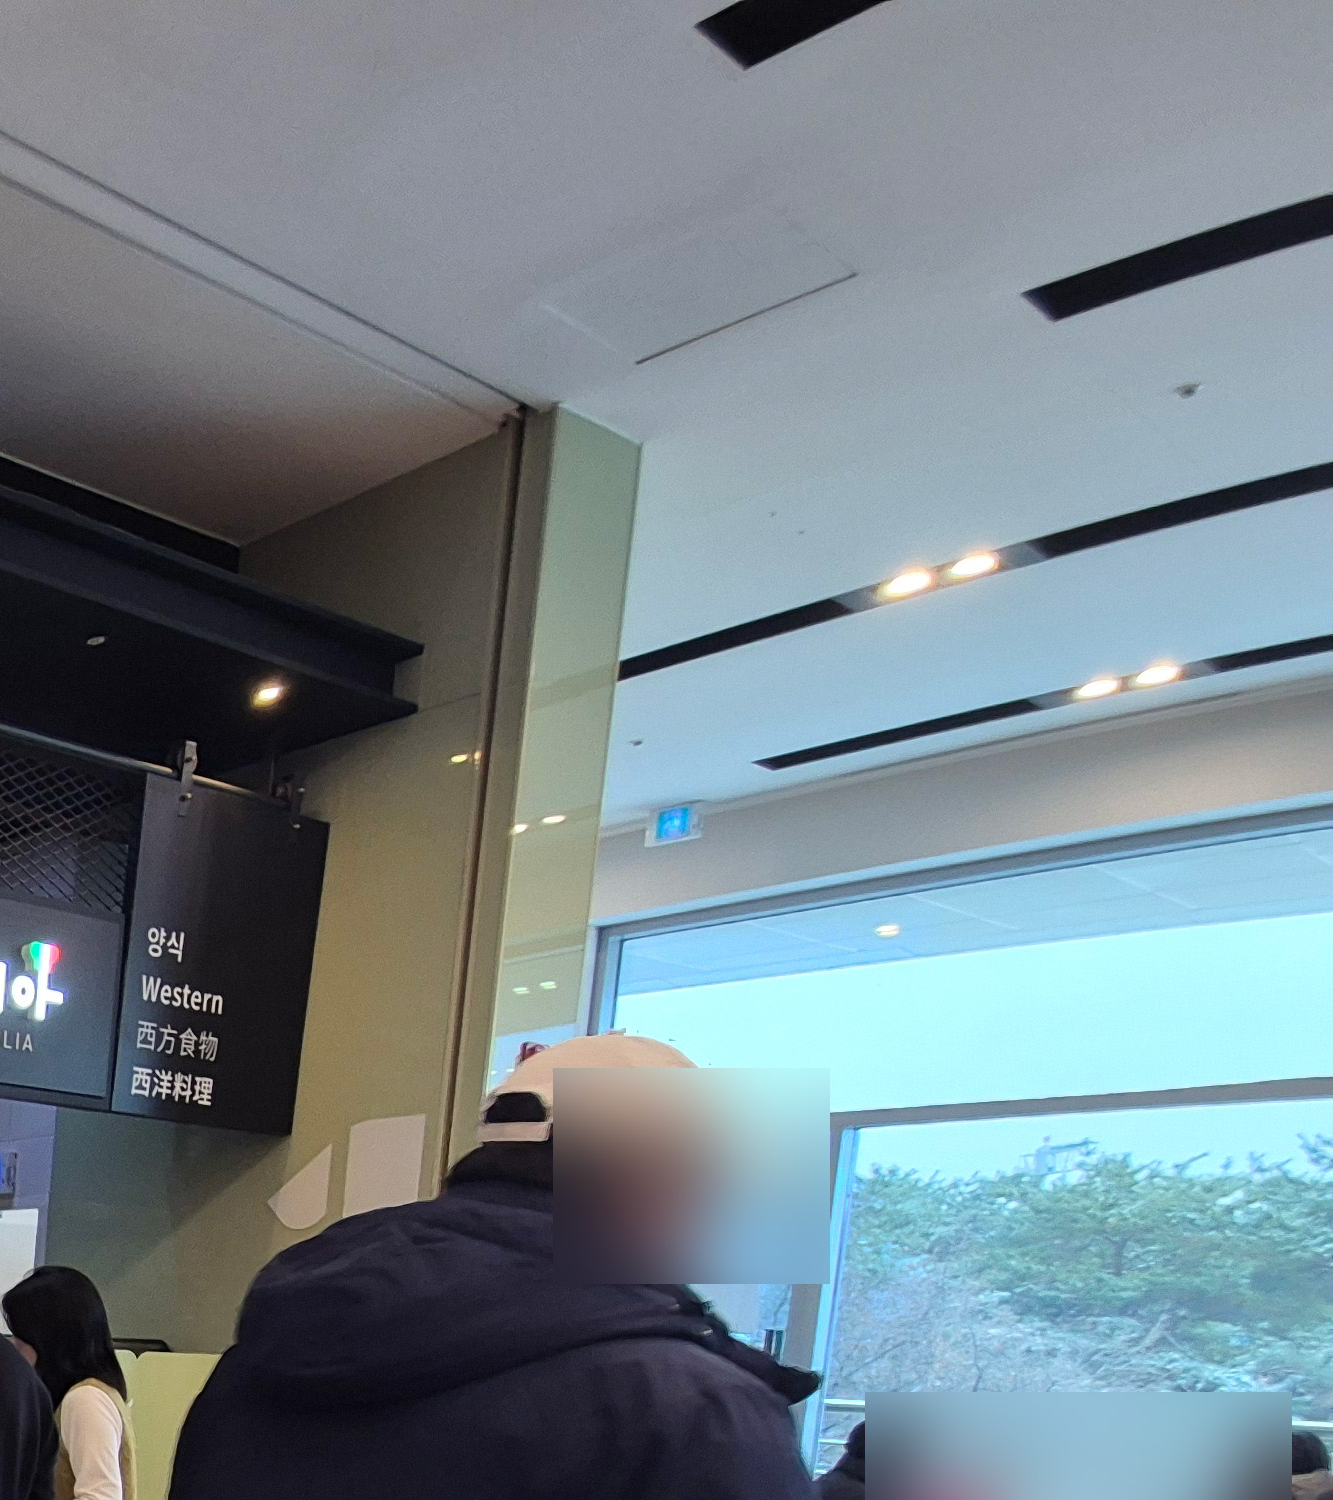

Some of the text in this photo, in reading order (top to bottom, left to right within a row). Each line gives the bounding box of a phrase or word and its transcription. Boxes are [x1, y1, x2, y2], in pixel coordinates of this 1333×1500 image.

[146, 926, 186, 964] 양식
[140, 974, 224, 1017] Western
[135, 1020, 220, 1063] 西方食物
[129, 1066, 215, 1108] 西洋料理
